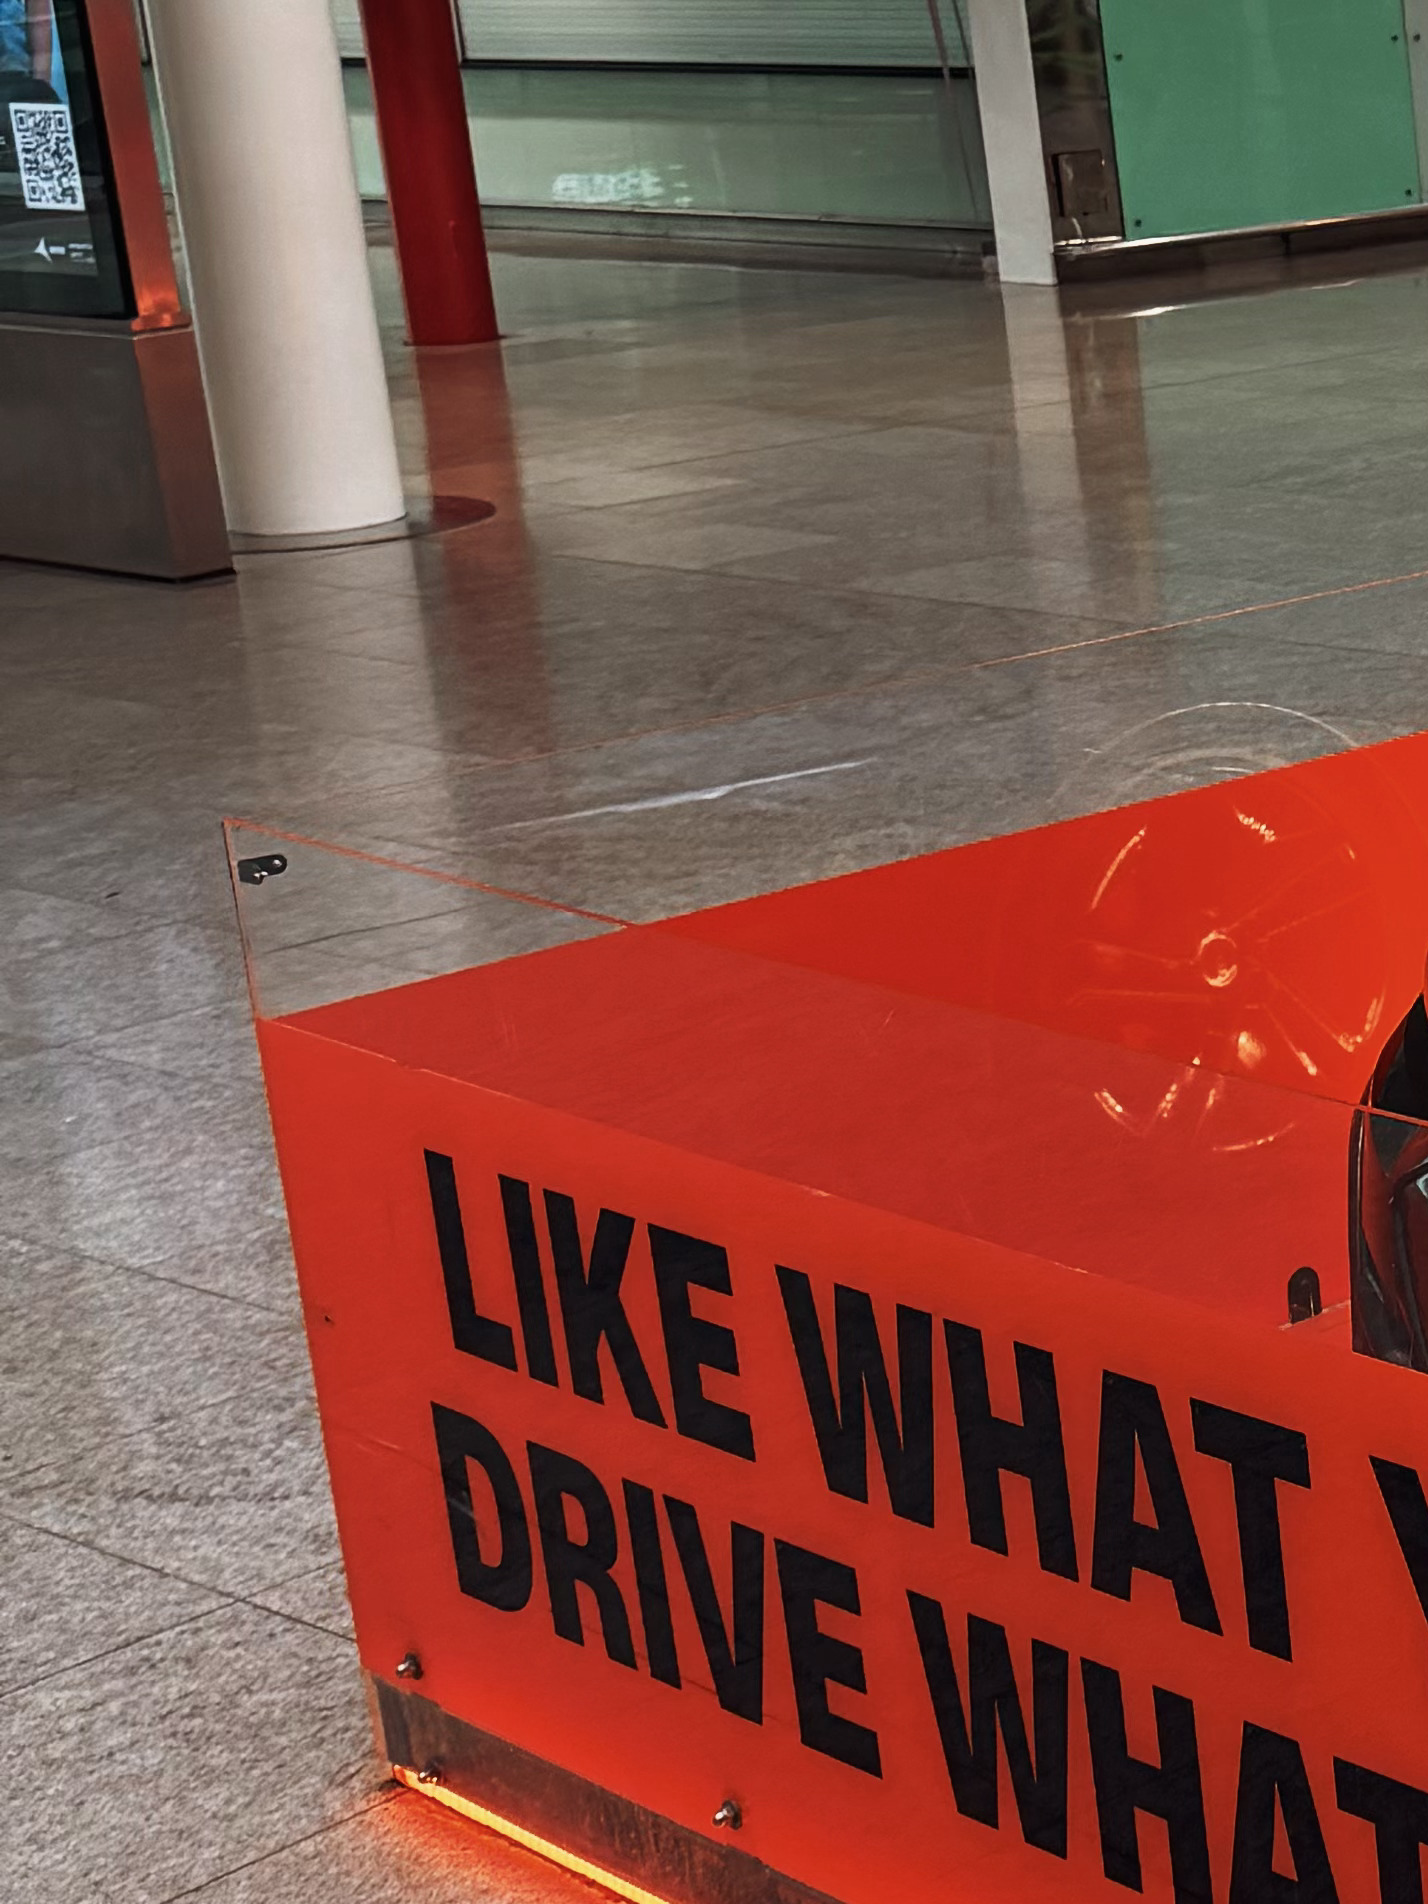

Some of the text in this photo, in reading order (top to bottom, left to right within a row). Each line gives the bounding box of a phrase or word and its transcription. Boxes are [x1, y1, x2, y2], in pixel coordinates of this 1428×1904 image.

[422, 1146, 757, 1463] LIKE
[774, 1263, 1312, 1663] WHAT
[430, 1399, 884, 1780] DRIVE
